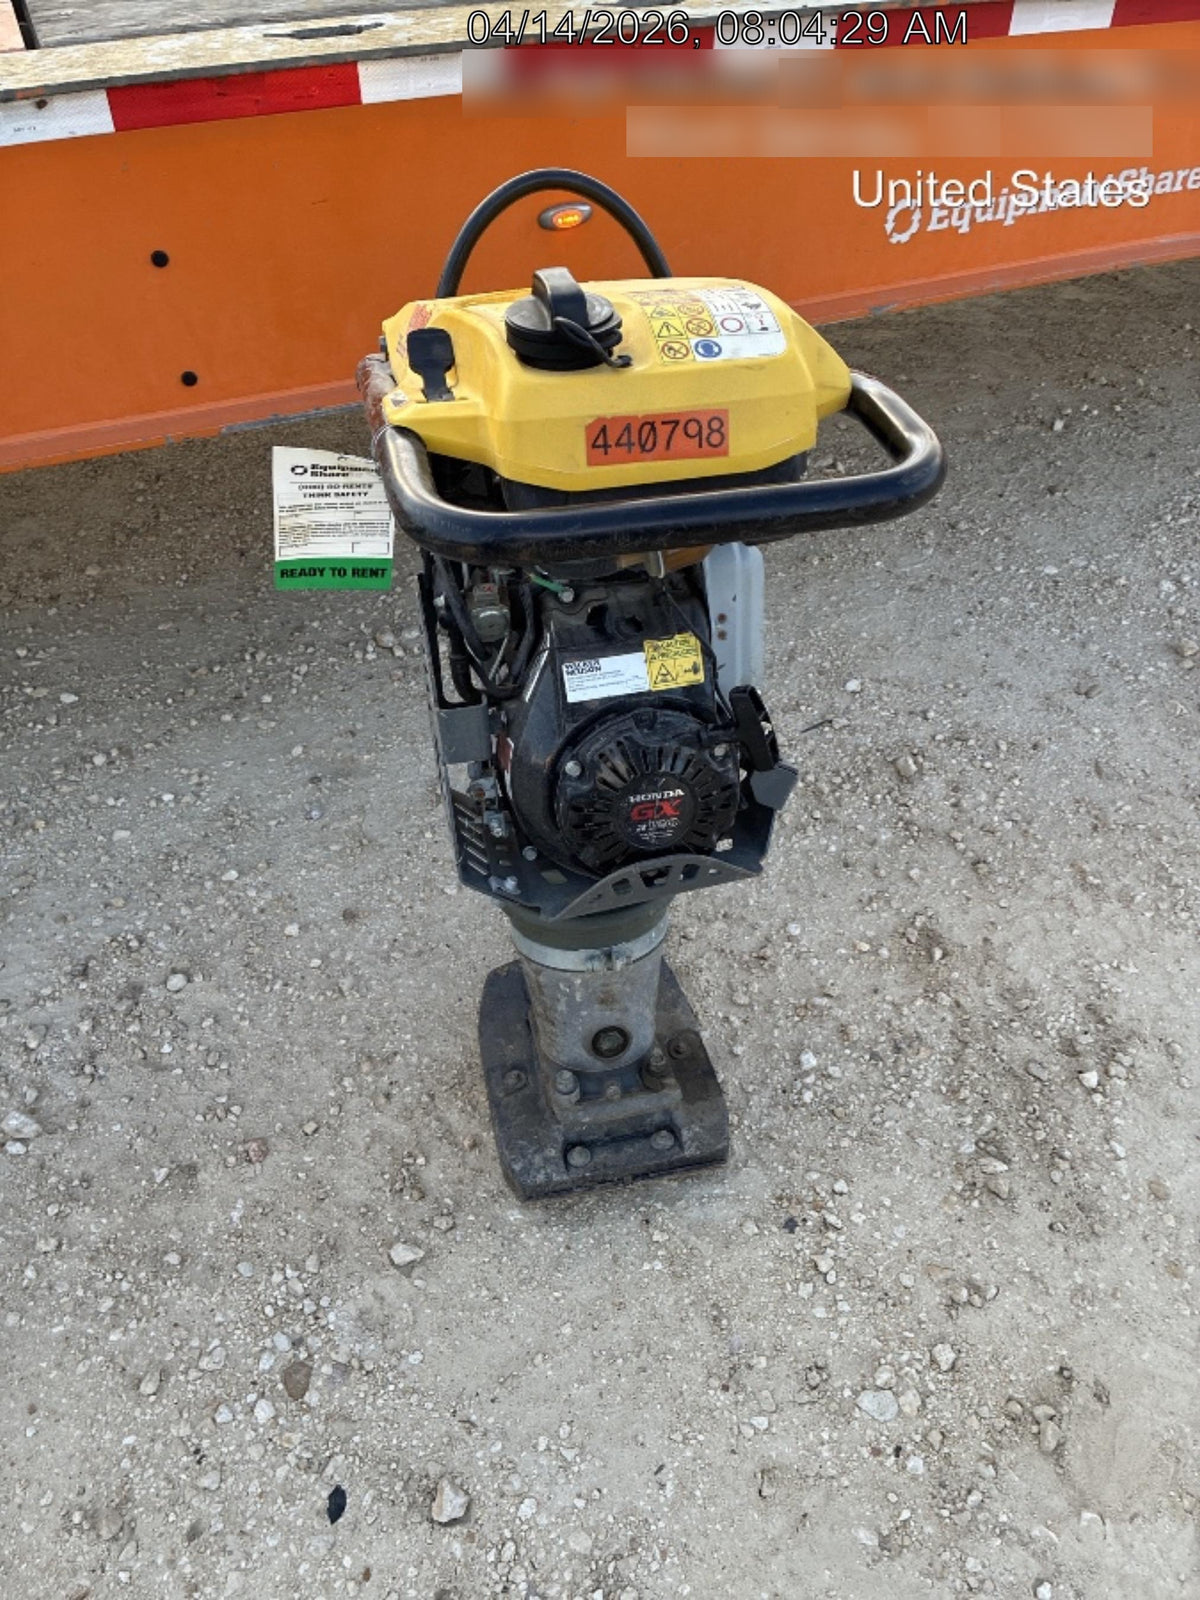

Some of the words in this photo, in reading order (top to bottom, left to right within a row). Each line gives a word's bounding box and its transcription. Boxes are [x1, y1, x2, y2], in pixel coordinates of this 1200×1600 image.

[591, 415, 726, 456] 440798
[310, 463, 379, 473] Equipme
[333, 490, 369, 498] SAFETY
[280, 566, 326, 579] READY
[329, 566, 348, 578] TO
[351, 567, 388, 579] RENT
[628, 788, 686, 803] HONDA
[629, 797, 683, 823] GX
